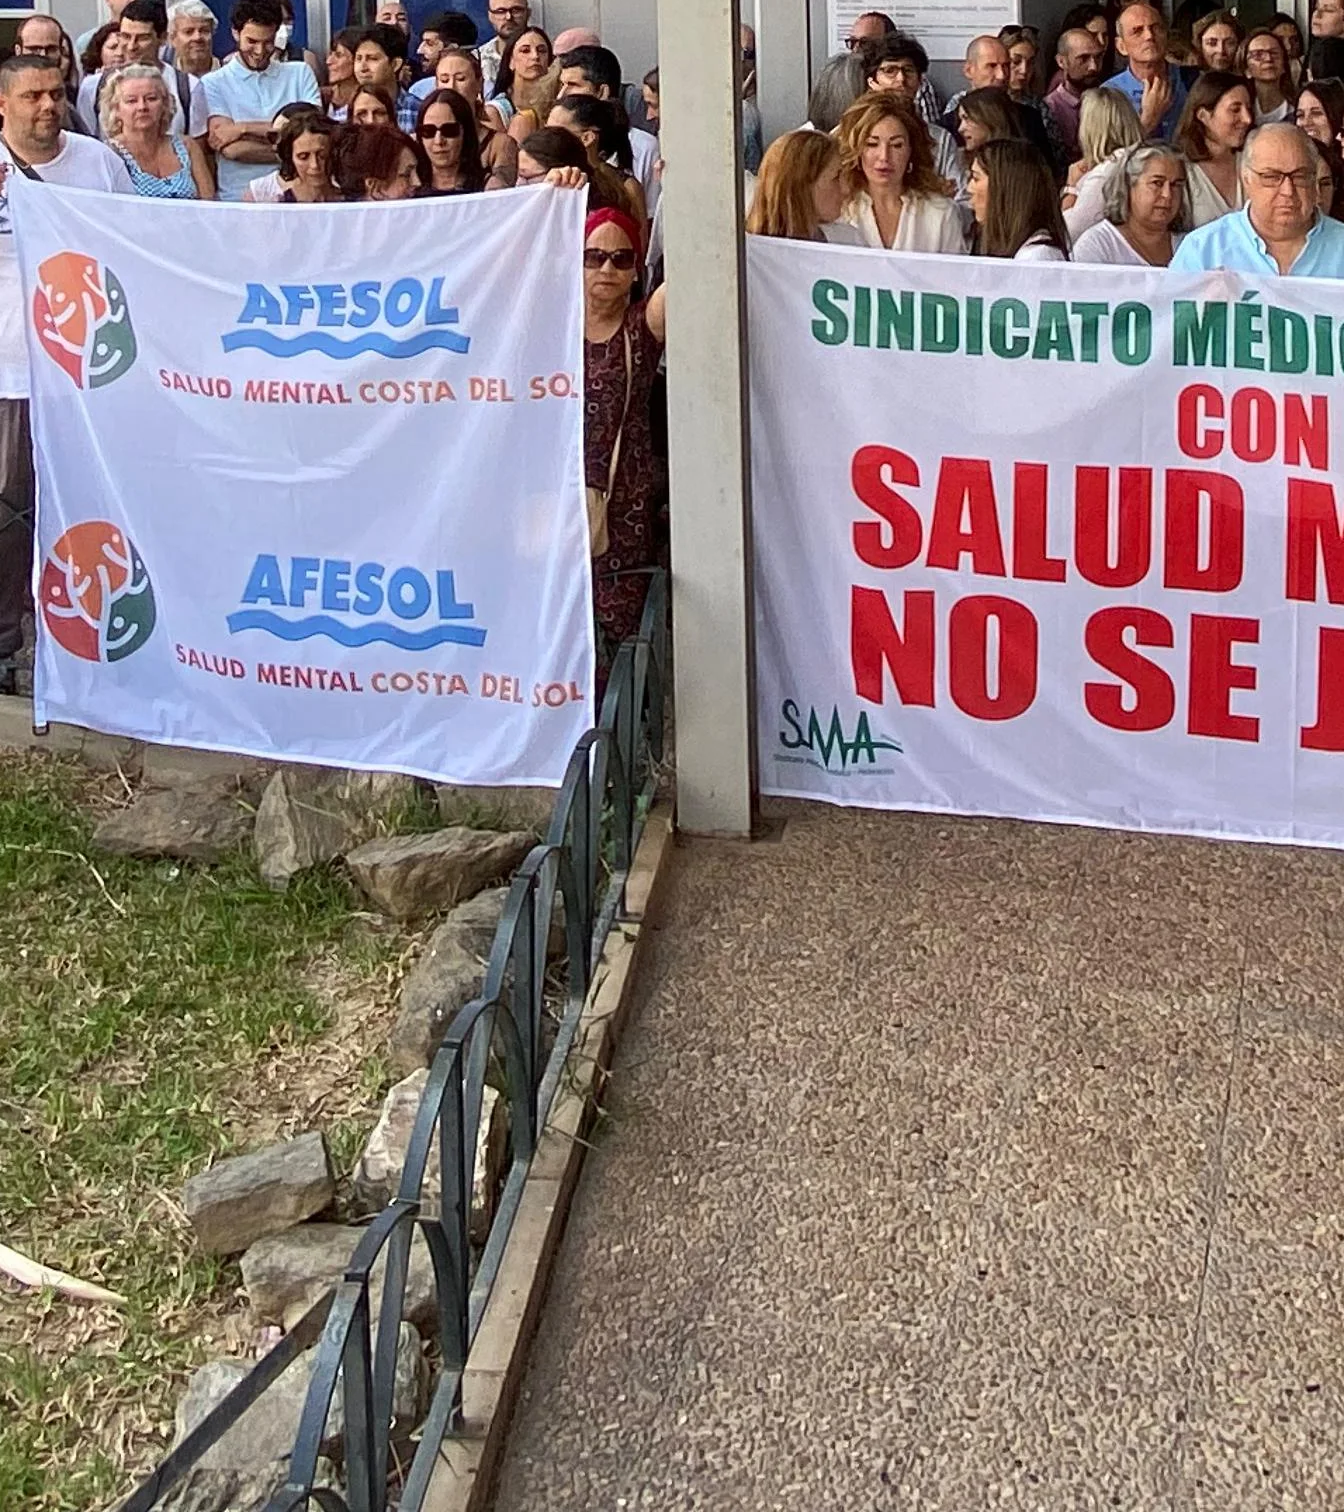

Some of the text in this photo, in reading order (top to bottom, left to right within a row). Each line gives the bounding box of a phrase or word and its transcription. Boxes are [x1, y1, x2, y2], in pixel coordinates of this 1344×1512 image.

[237, 276, 459, 327] AFESOL
[811, 278, 1152, 366] SINDICATO
[158, 368, 232, 399] SALUD
[244, 377, 352, 404] MENTAL
[359, 375, 456, 404] COSTA
[468, 376, 515, 402] DEL
[1177, 383, 1329, 472] CON
[851, 444, 1245, 592] SALUD
[241, 553, 475, 621] AFESOL
[175, 642, 585, 708] SALUD MENTAL COSTA DEL SOL
[852, 584, 1039, 723] NO
[1083, 605, 1260, 743] SE
[779, 698, 903, 769] SMA
